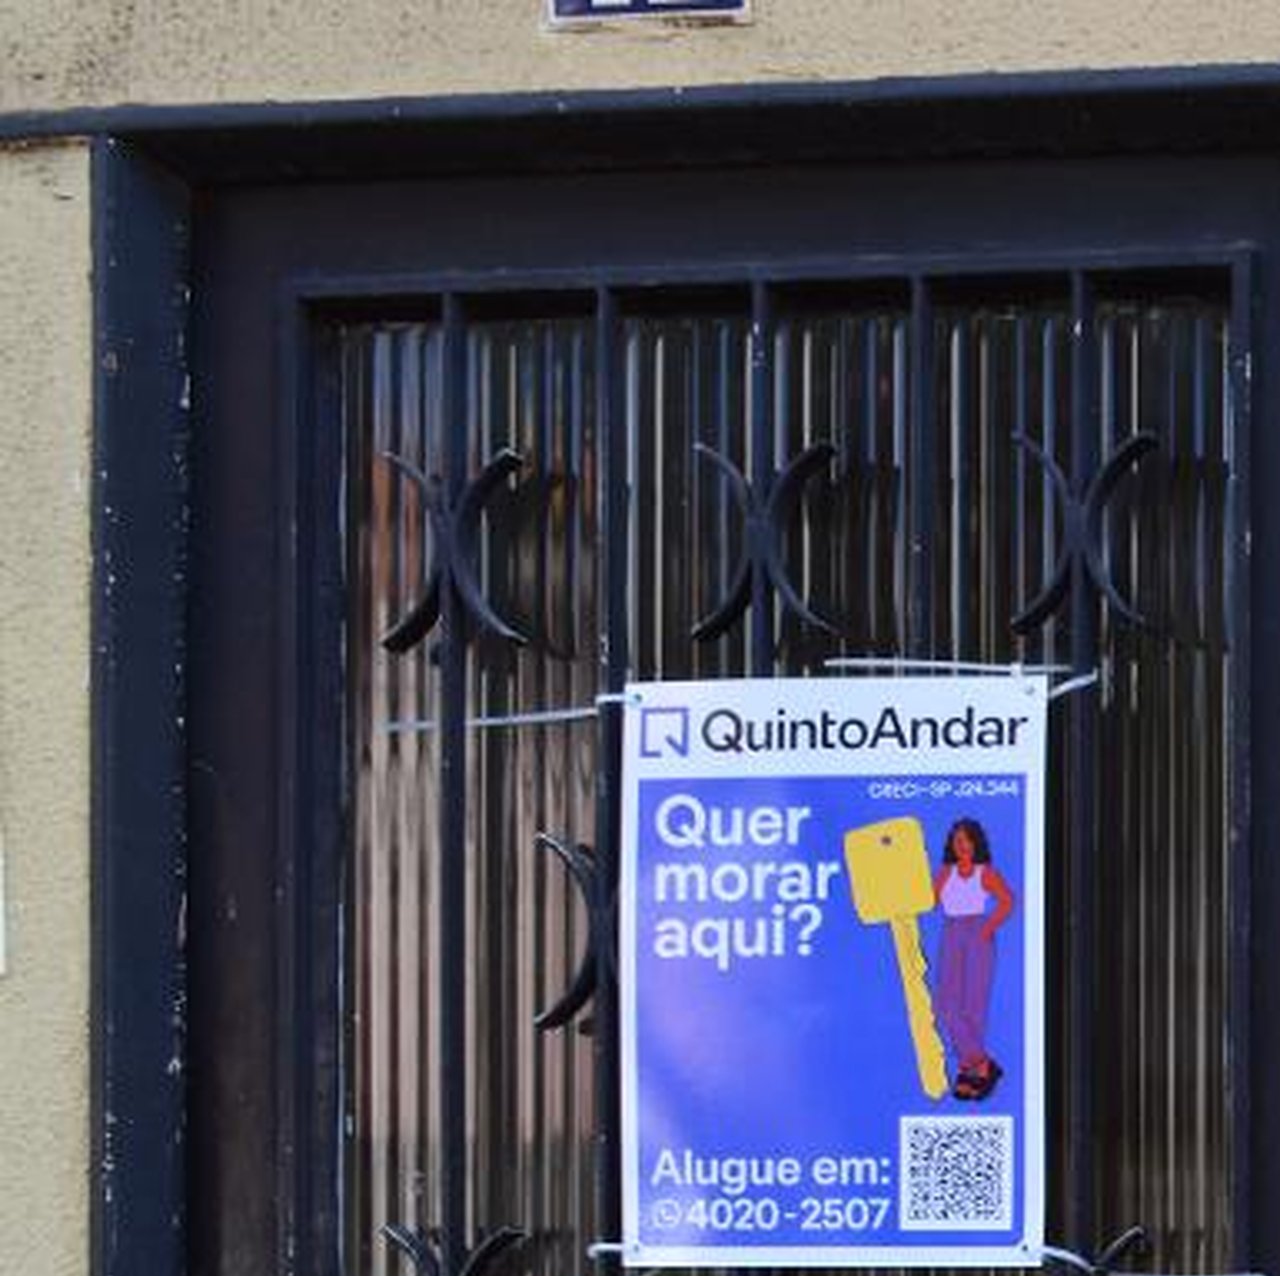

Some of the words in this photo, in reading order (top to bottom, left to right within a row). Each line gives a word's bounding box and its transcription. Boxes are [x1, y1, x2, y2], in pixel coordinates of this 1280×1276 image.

[701, 706, 1029, 753] QuintoAndar
[655, 794, 811, 848] Quer
[655, 862, 840, 901] morar
[654, 904, 823, 971] aqui?
[651, 1149, 800, 1194] Alugue
[813, 1156, 891, 1185] em:
